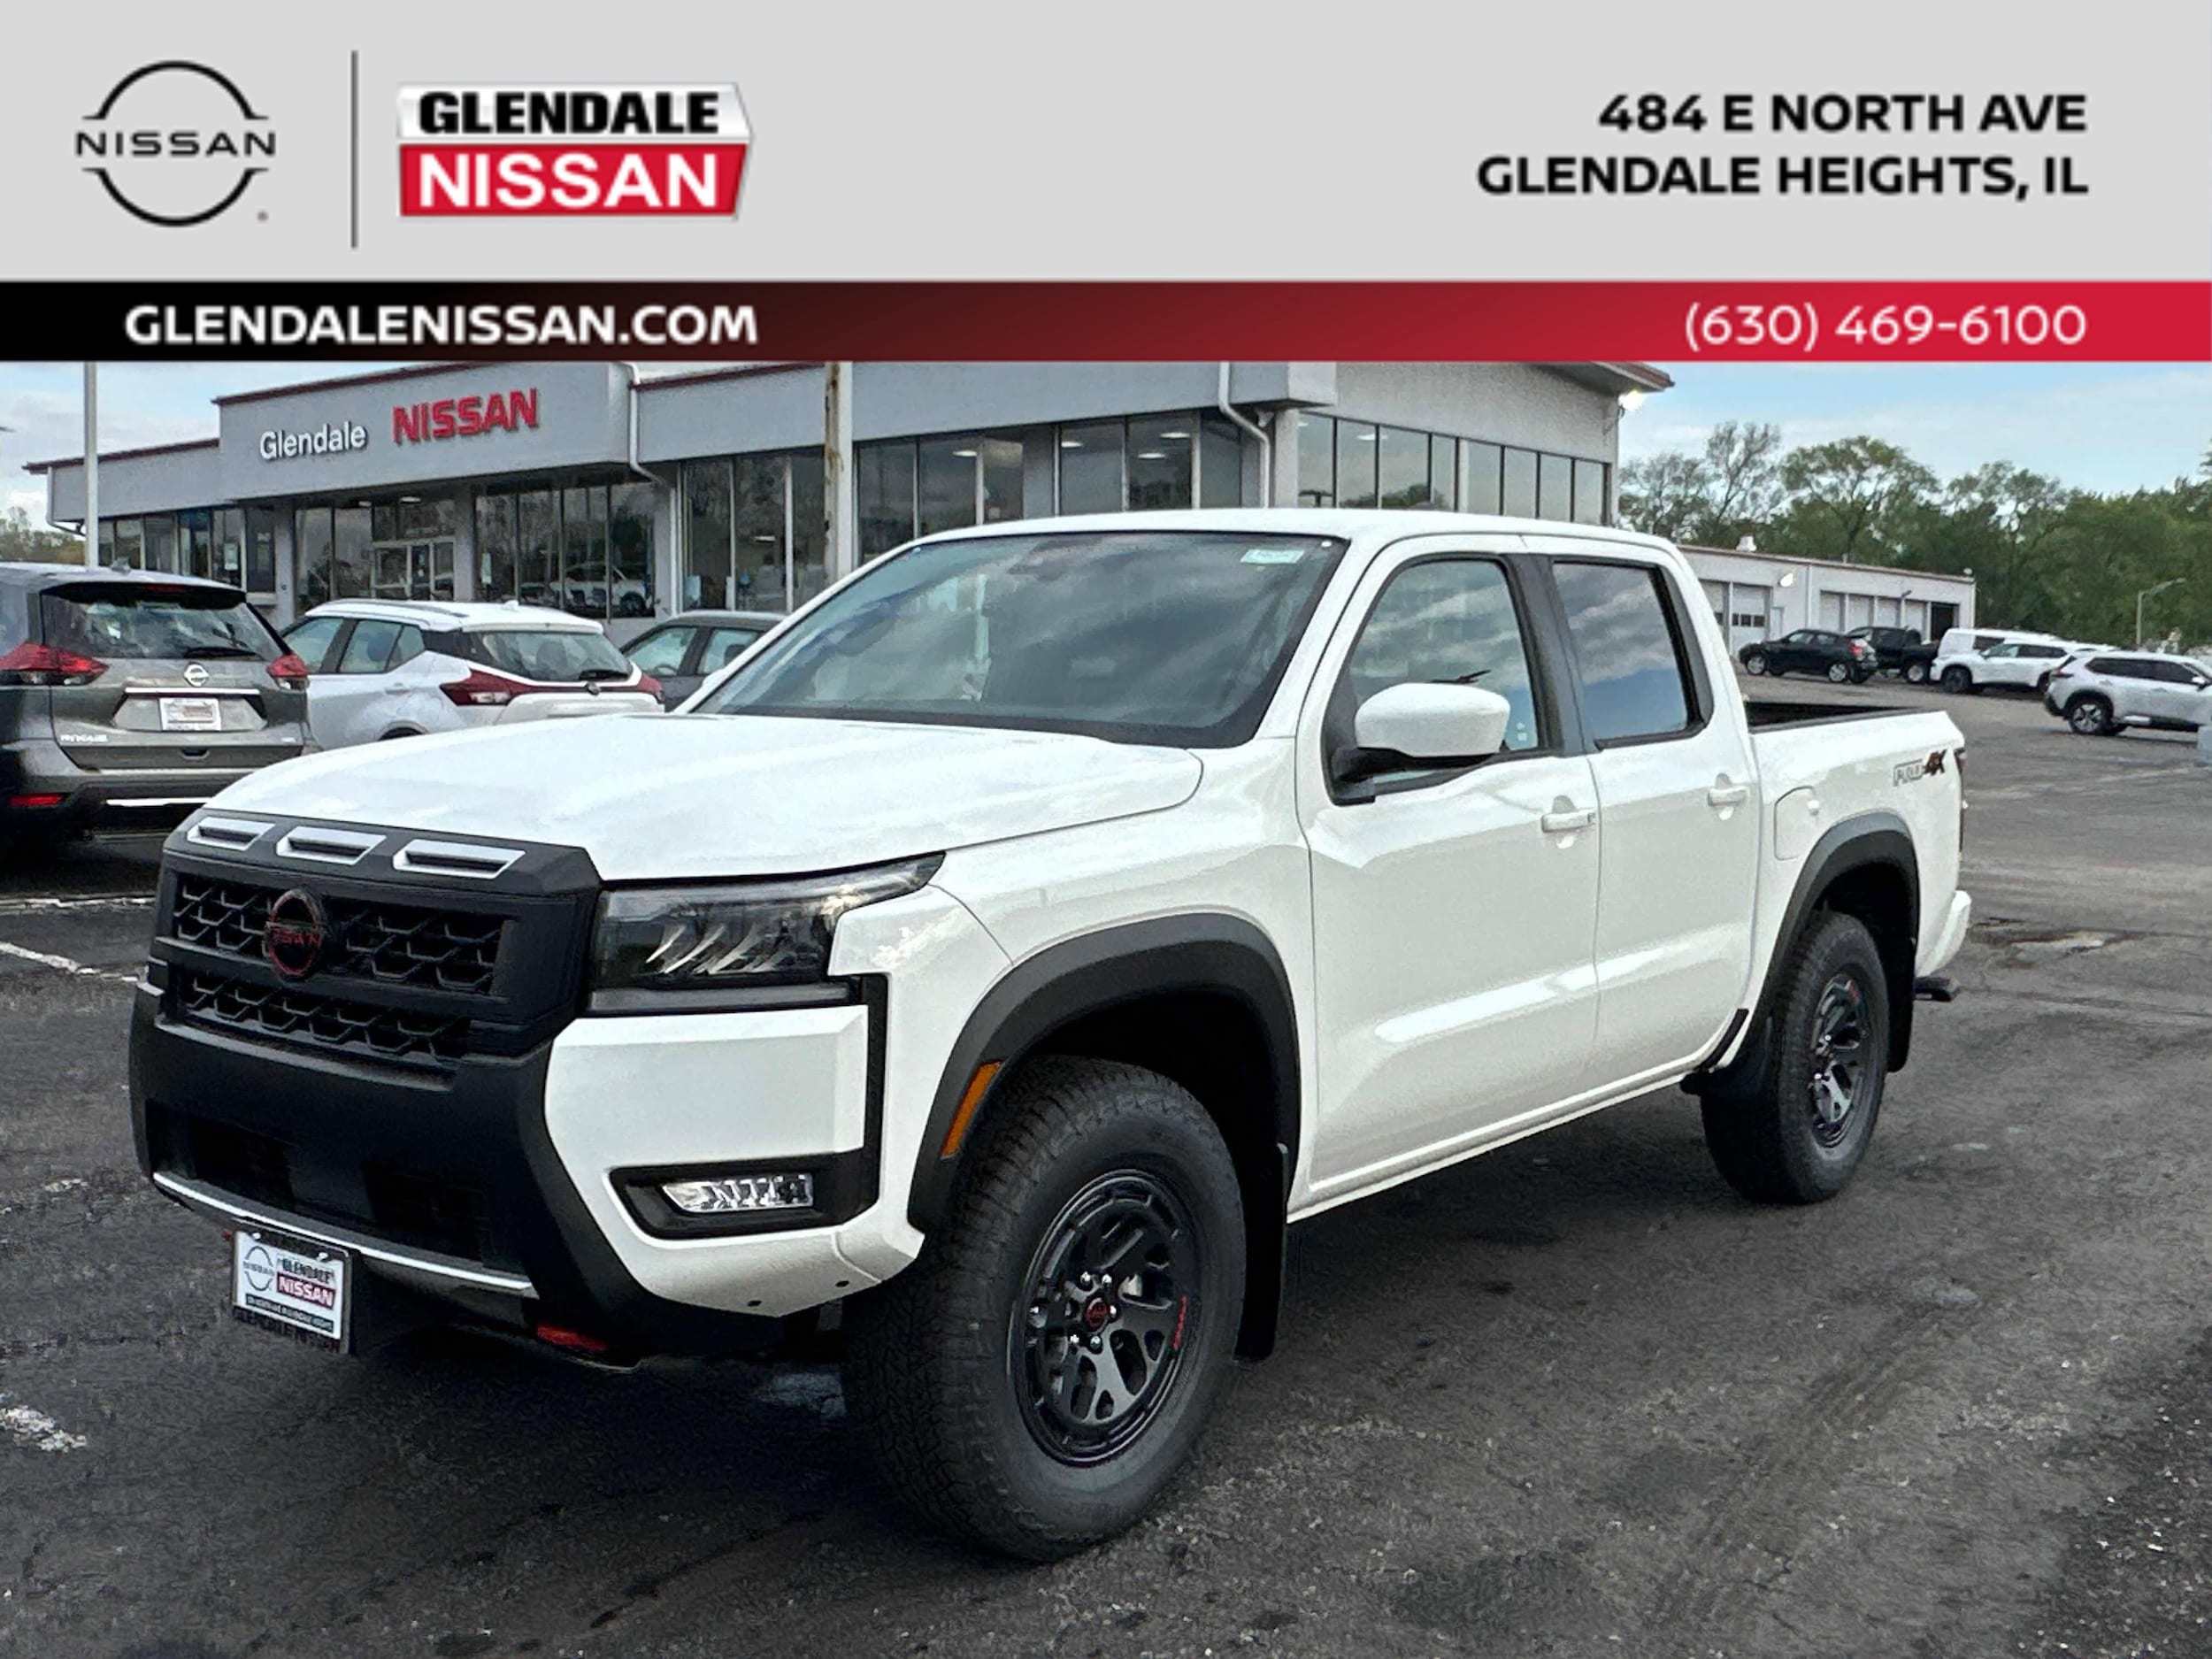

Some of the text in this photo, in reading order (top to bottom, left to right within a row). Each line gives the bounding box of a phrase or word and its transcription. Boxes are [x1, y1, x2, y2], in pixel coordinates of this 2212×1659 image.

[259, 388, 539, 461] Glendale NISSAN
[279, 1275, 334, 1307] NISSAN
